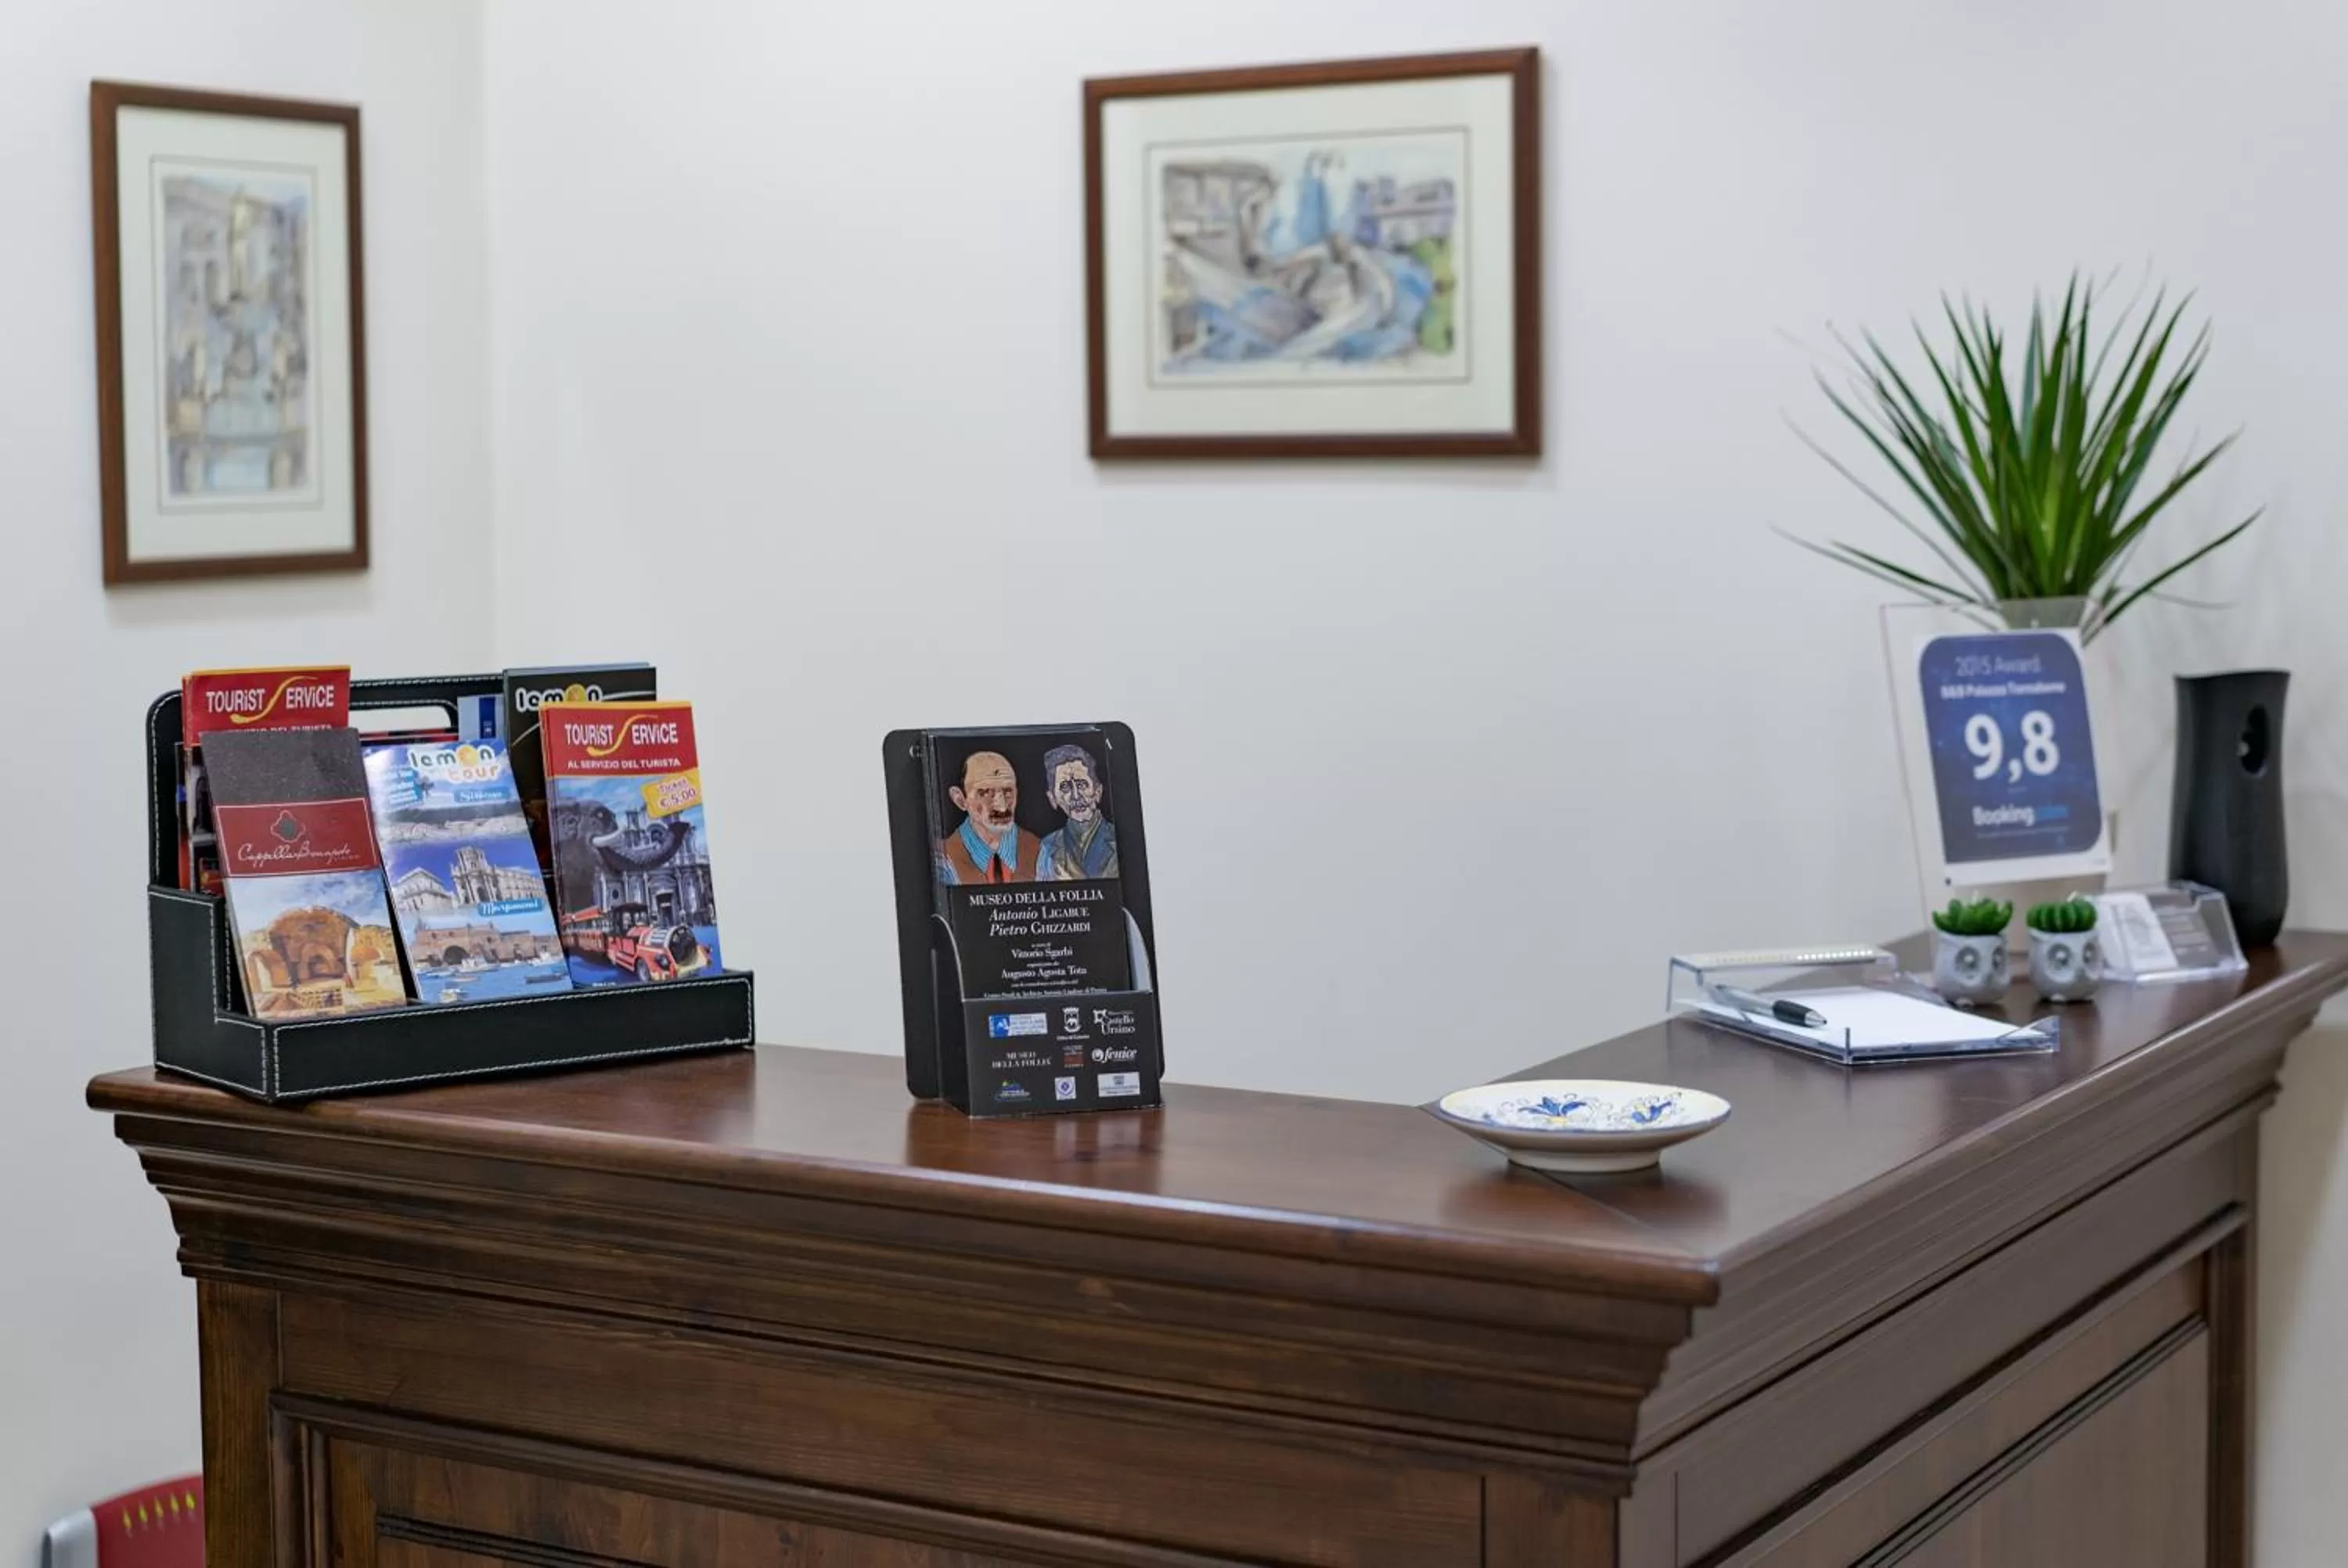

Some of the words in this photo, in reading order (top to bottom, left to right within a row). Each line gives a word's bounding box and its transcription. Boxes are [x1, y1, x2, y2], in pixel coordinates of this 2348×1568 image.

[1955, 656, 1992, 676] 2015
[1995, 656, 2041, 673] Award
[1964, 710, 2060, 782] 9,8
[409, 745, 495, 767] lemon
[567, 760, 579, 769] AL
[581, 760, 619, 769] SERVIZIO
[623, 759, 637, 768] DEL
[640, 758, 681, 768] TURISTA
[447, 764, 499, 782] tour
[1972, 804, 2069, 826] Booking
[969, 894, 1012, 907] MUSEO
[1015, 891, 1057, 904] DELLA
[1059, 890, 1104, 901] FOLLIA
[989, 907, 1039, 922] Antonio
[989, 922, 1028, 937] Pietro
[1011, 948, 1044, 958] Vittorio
[1045, 946, 1073, 959] Sgarbi
